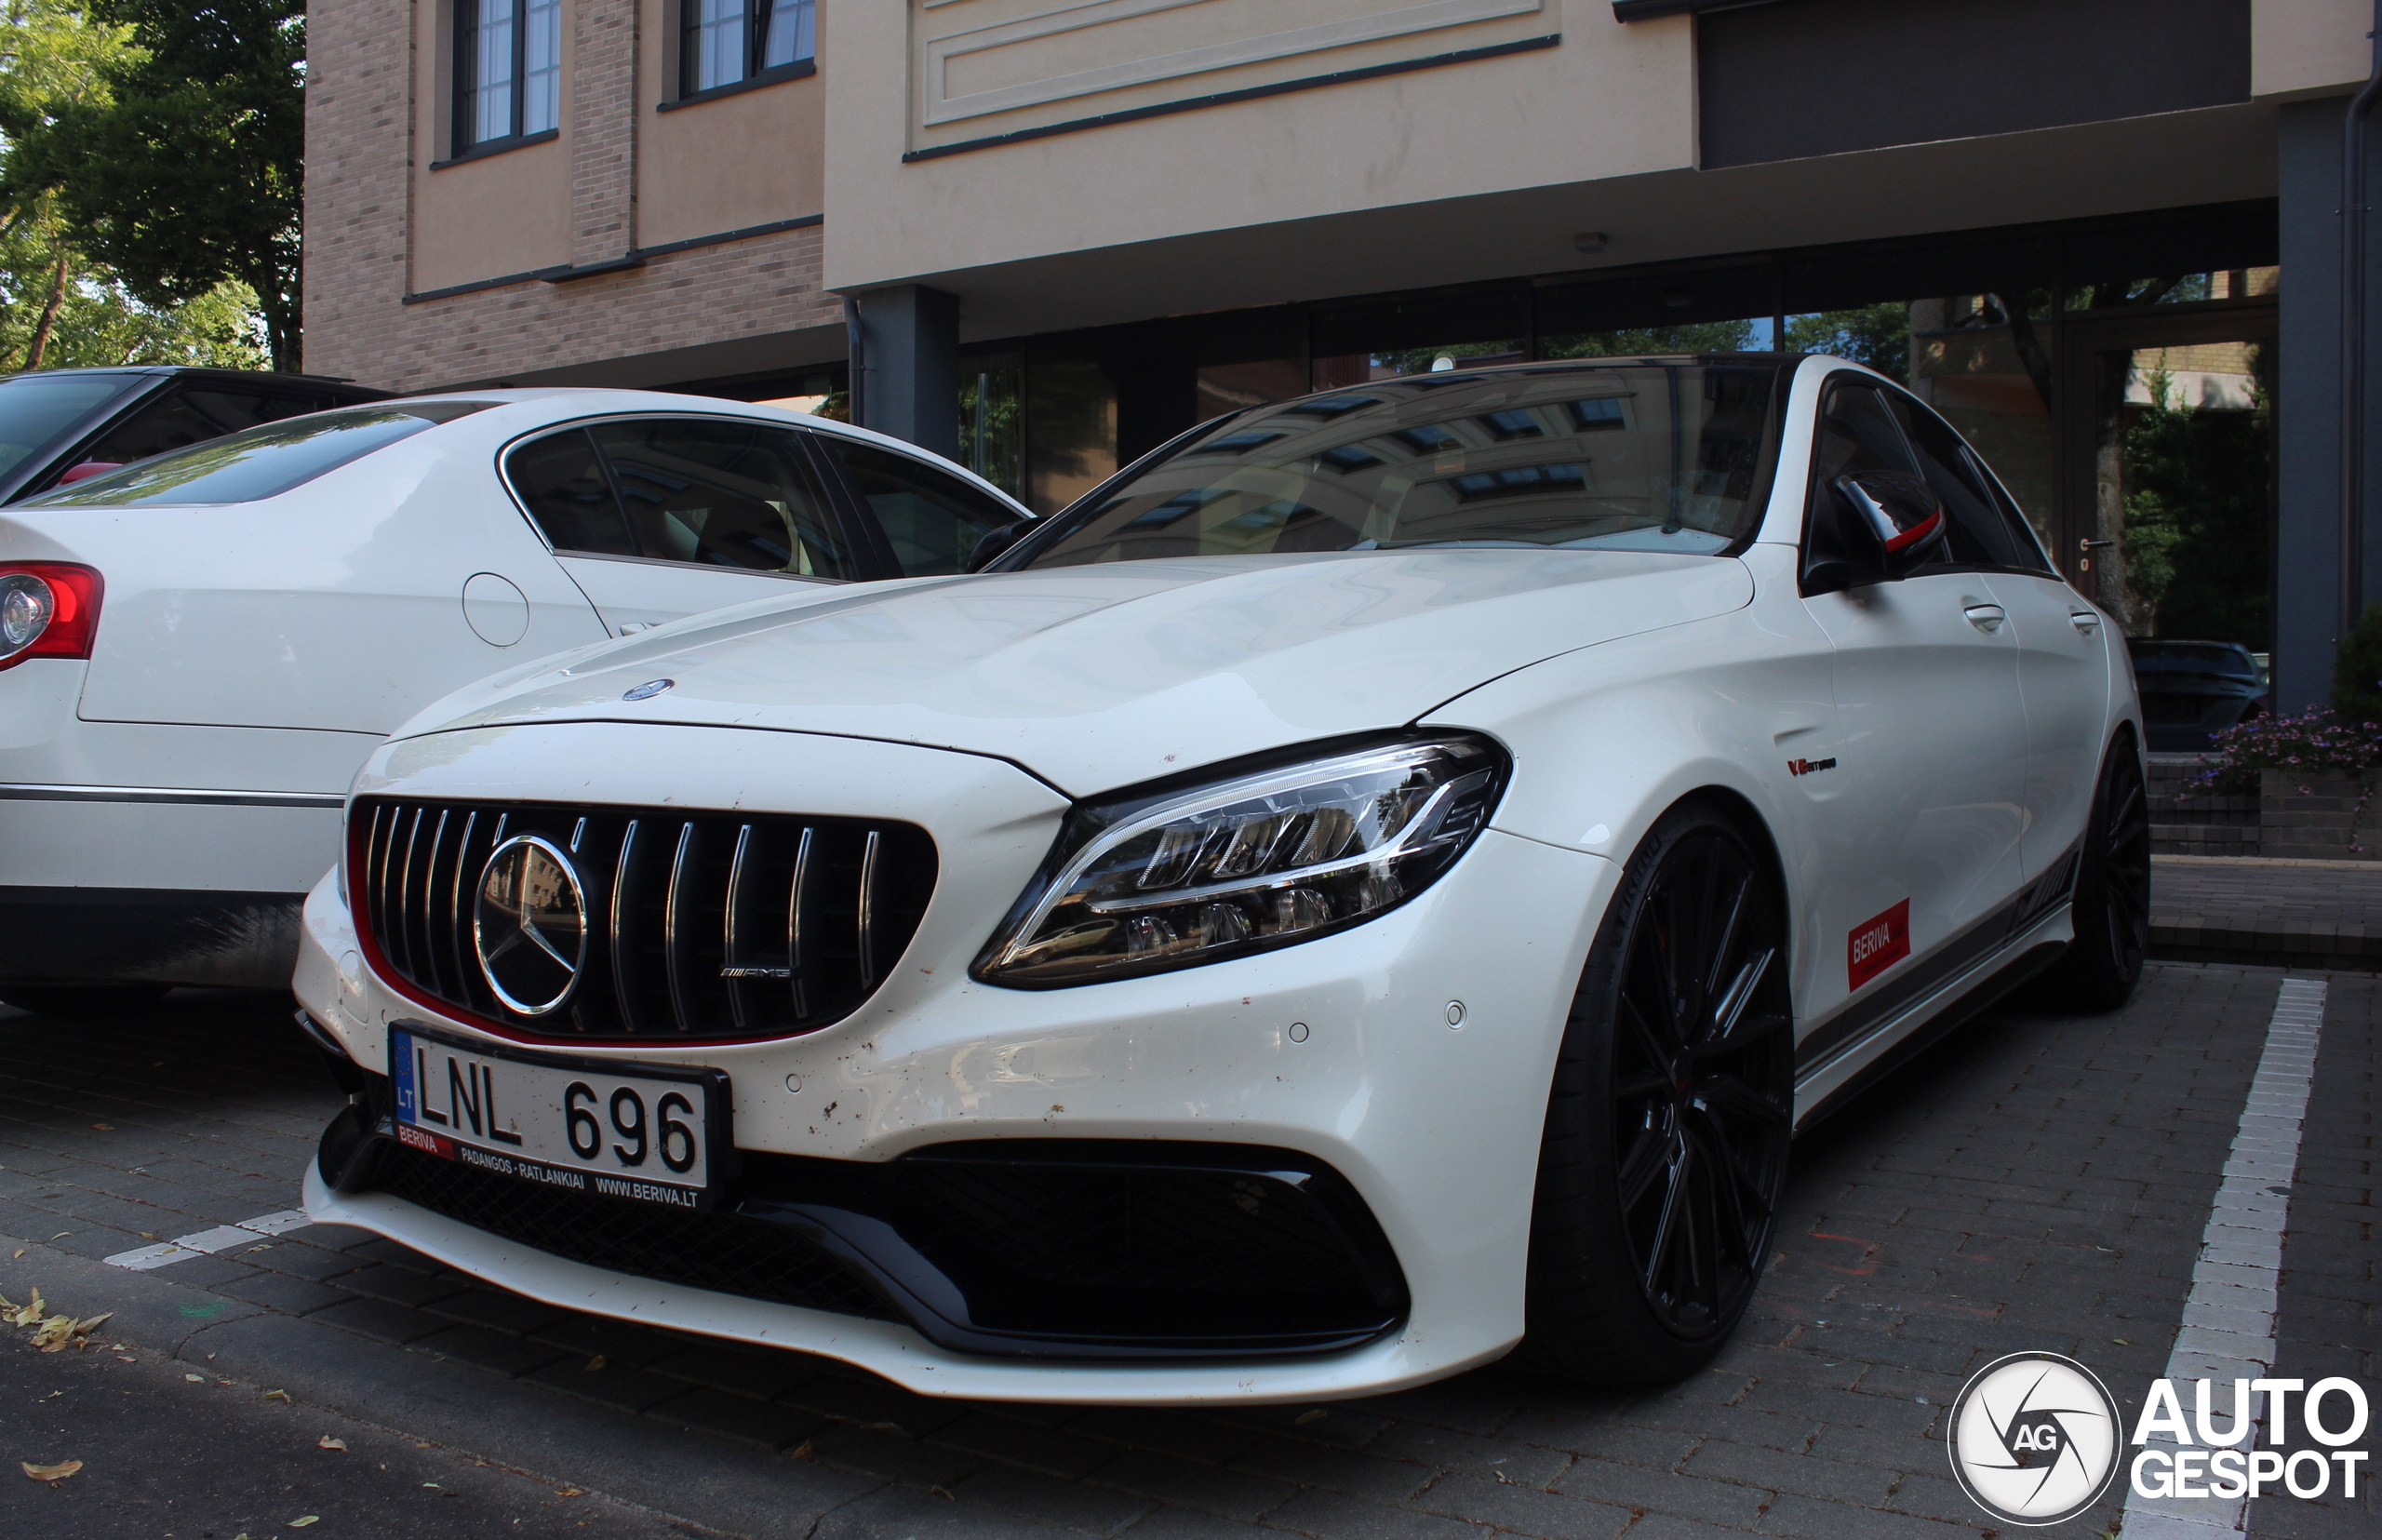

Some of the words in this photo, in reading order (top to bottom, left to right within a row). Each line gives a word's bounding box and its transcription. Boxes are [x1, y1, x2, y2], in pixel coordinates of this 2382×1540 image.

[1853, 921, 1890, 965] BERIVA
[742, 968, 791, 977] AMG
[397, 1086, 413, 1109] LT
[417, 1046, 522, 1146] LNL
[564, 1079, 696, 1173] 696
[398, 1125, 437, 1153] BERIVA
[461, 1146, 513, 1174] PADANGOS
[518, 1163, 585, 1190] RATLANKIAI
[595, 1177, 698, 1208] WWW.BERIVA.LT
